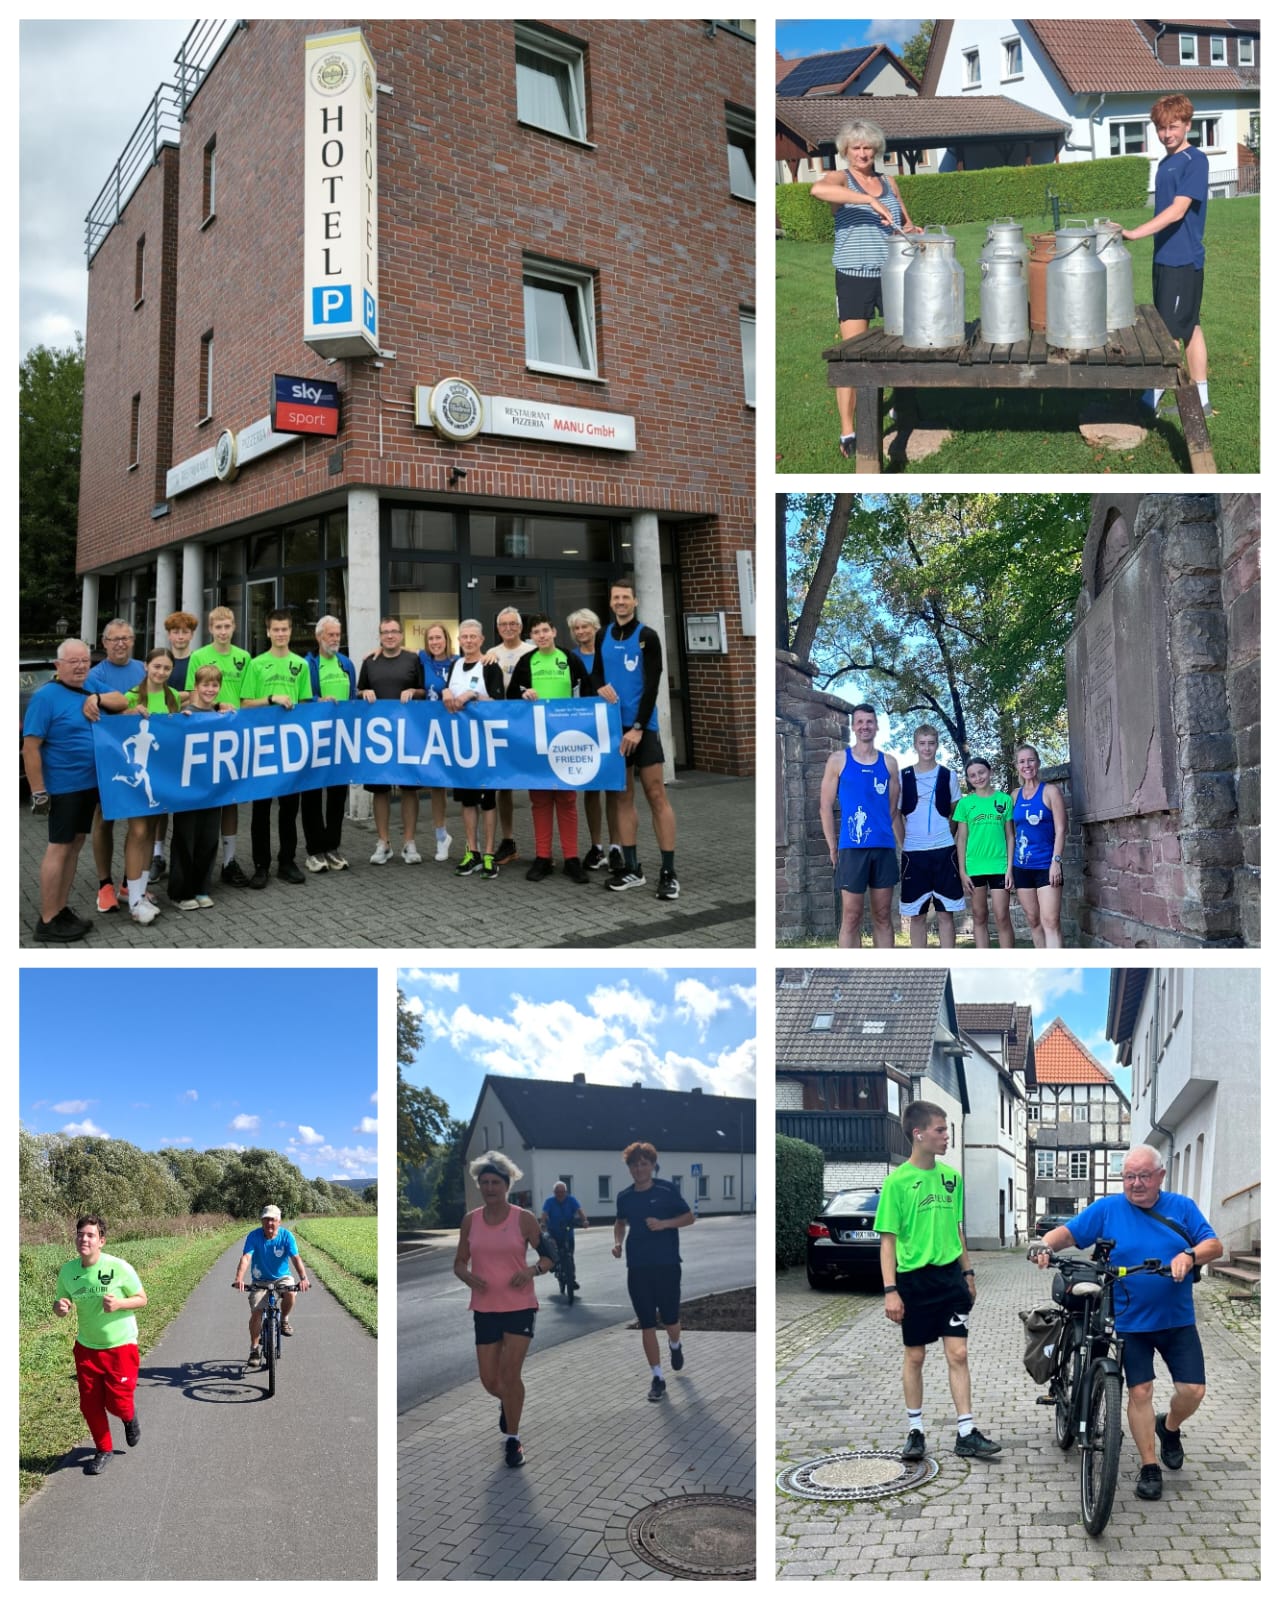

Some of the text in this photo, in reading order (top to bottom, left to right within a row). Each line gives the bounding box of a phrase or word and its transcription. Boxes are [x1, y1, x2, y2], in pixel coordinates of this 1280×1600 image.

[319, 105, 344, 276] HOTEL
[364, 113, 373, 286] HOTEL
[321, 290, 344, 321] P
[366, 295, 374, 326] P
[291, 383, 323, 404] sky
[288, 411, 326, 426] sport
[505, 407, 551, 421] RESTAURANT
[512, 417, 545, 429] PIZZERIA
[553, 419, 615, 438] MANU GmbH
[181, 717, 509, 787] FRIEDENSLAUF
[552, 744, 594, 753] ZUKUNFT
[555, 755, 594, 764] FRIEDEN
[568, 766, 583, 775] E.V.
